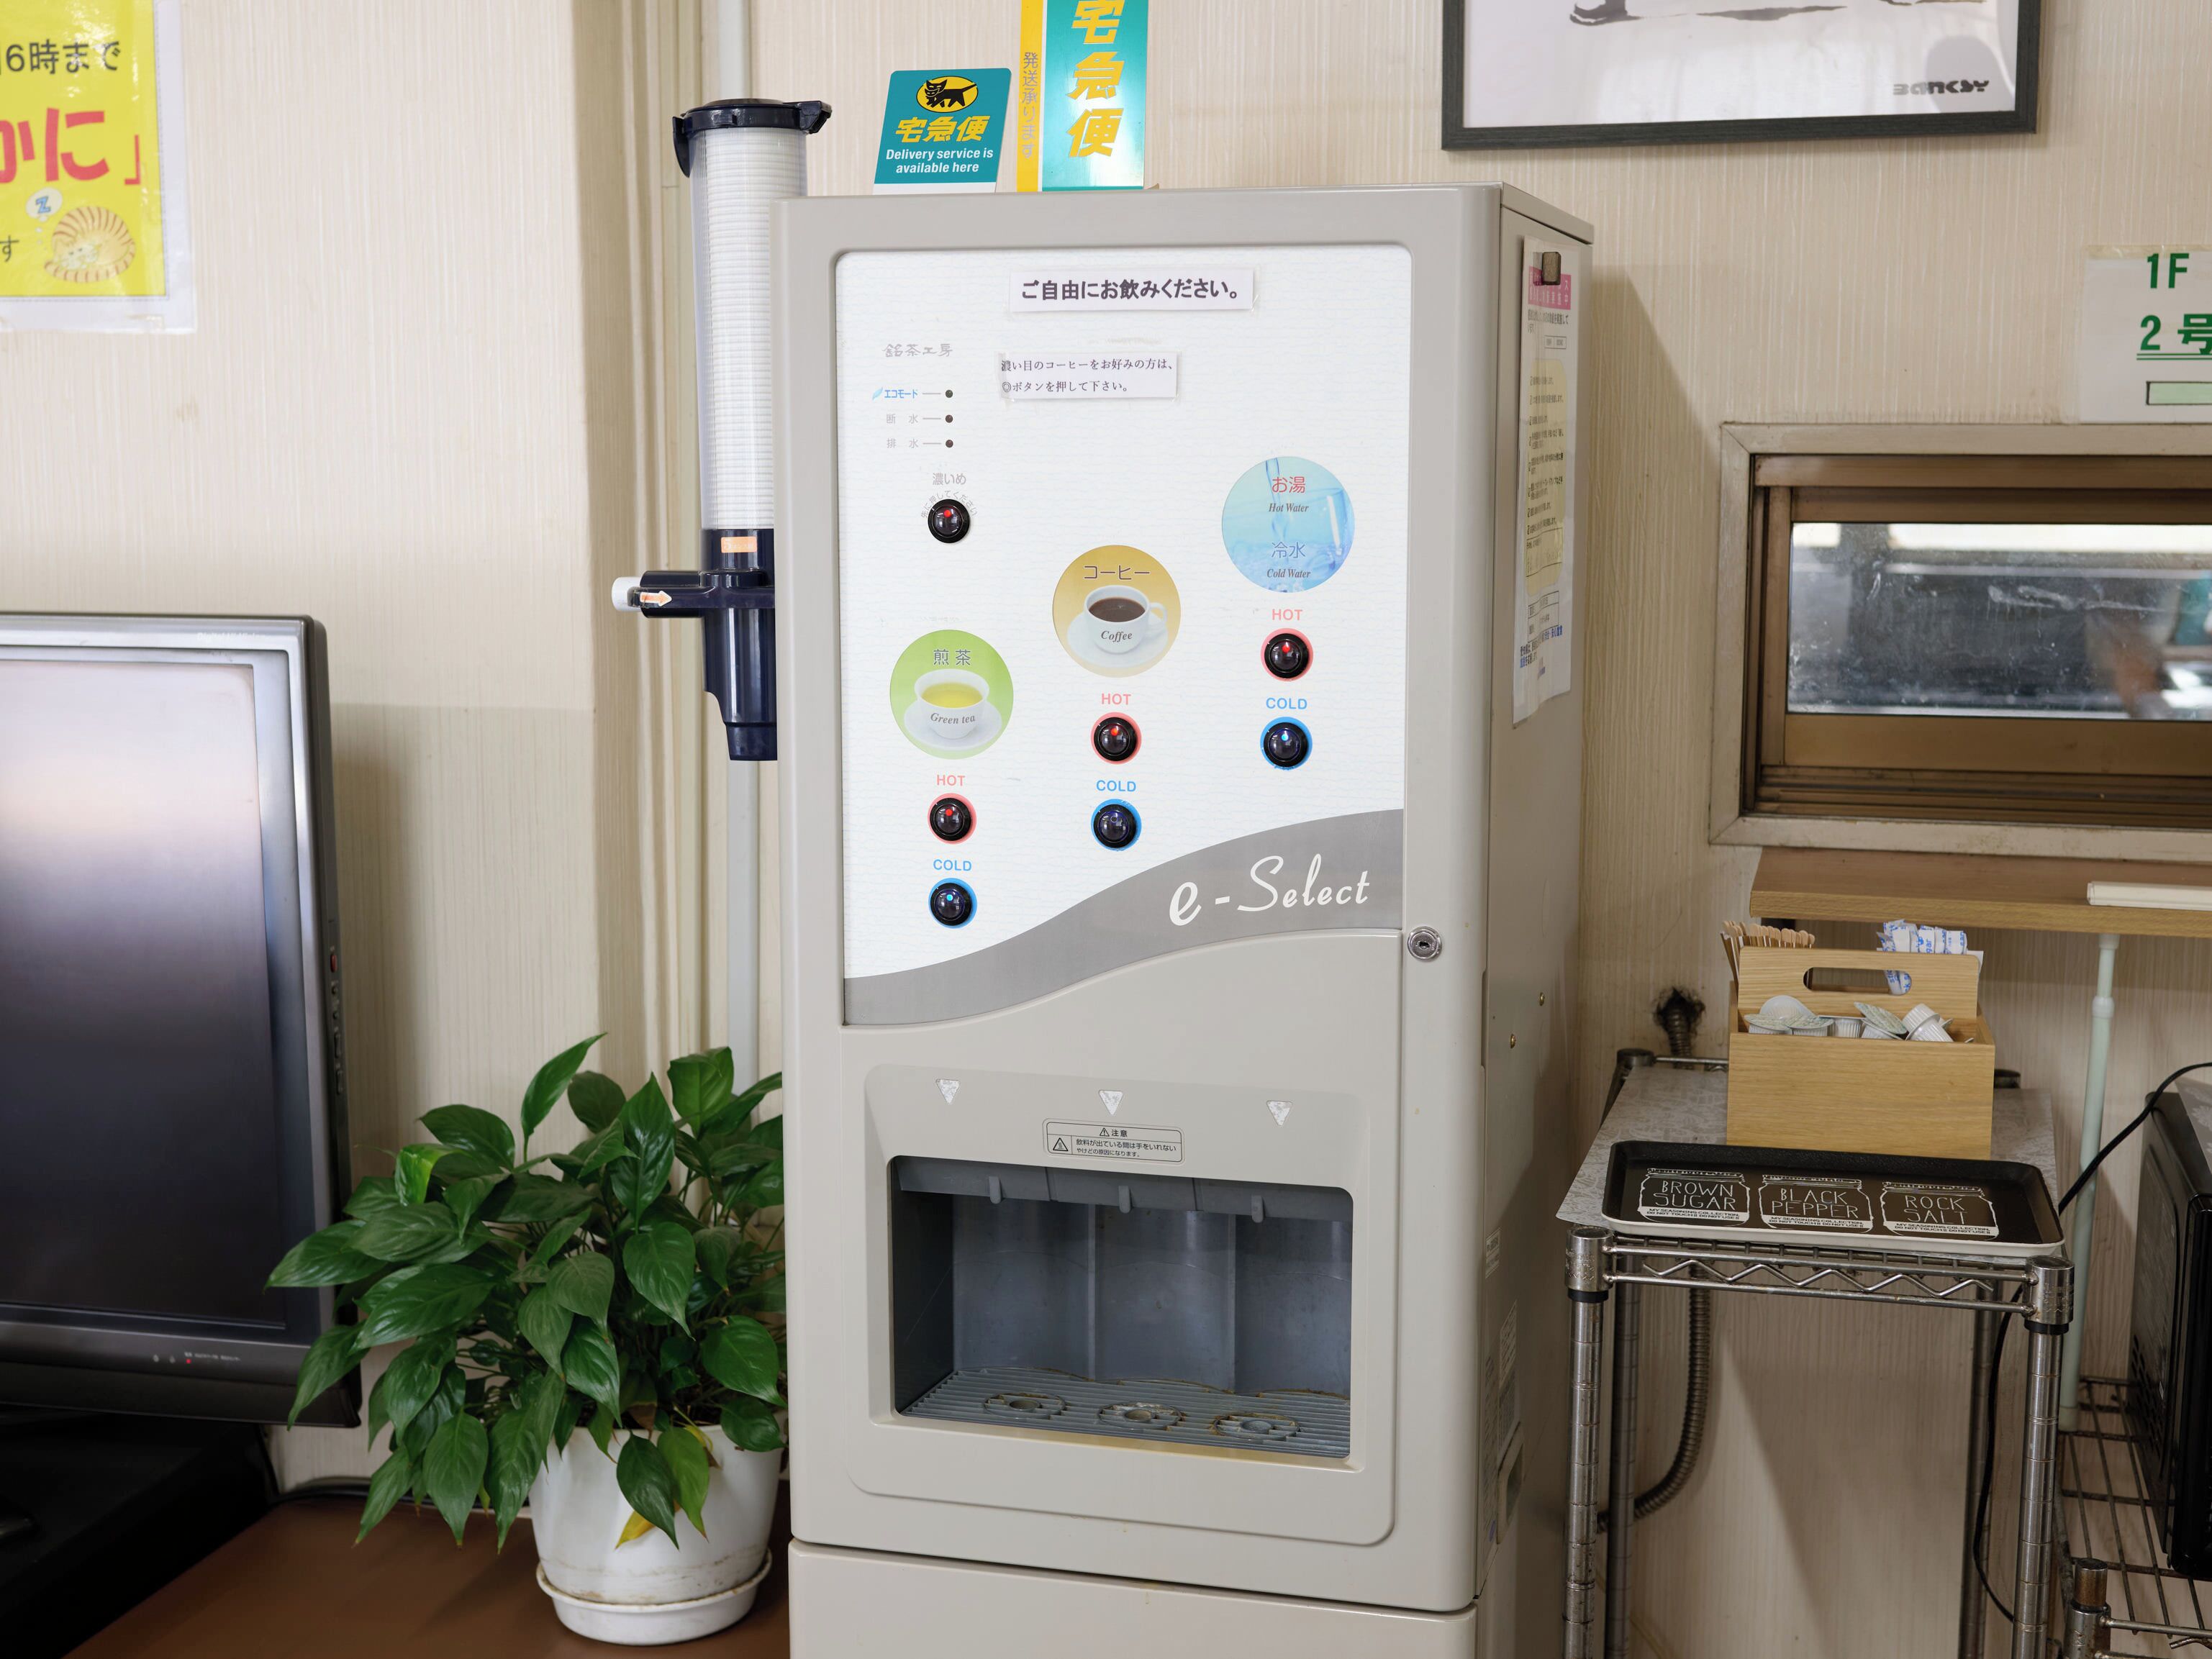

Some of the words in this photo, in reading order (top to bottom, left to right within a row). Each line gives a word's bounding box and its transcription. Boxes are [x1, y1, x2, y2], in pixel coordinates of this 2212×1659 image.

[0, 39, 121, 75] 6時まで
[1021, 52, 1038, 159] 発送承ります
[895, 115, 991, 142] 宅急便
[886, 149, 935, 161] Delivery
[937, 148, 981, 159] service
[983, 147, 994, 158] is
[896, 162, 950, 174] available
[952, 162, 979, 173] here
[2147, 253, 2190, 288] 1F
[1021, 278, 1238, 301] ご自由にお飲みください。
[1001, 358, 1174, 372] 濃い目のコーヒーをお好みの方は、
[884, 388, 918, 399] エコモード
[933, 472, 967, 486] 濃いめ
[1272, 476, 1306, 494] お湯
[1269, 502, 1284, 512] Hot
[1286, 502, 1309, 512] Water
[1271, 541, 1306, 559] 冷水
[1084, 565, 1151, 580] コーヒー
[1266, 568, 1285, 578] Cold
[1287, 568, 1311, 578] Water
[1272, 609, 1303, 621] HOT
[1100, 629, 1133, 642] Coffee
[933, 648, 971, 666] 煎茶
[1101, 693, 1132, 705] HOT
[1266, 697, 1307, 709] COLD
[930, 712, 959, 724] Green
[961, 714, 976, 724] tea
[936, 774, 966, 786] HOT
[1096, 780, 1136, 792] COLD
[933, 859, 972, 871] COLD
[1111, 1129, 1128, 1137] 注意
[1076, 1138, 1177, 1152] 飲料が出ている間は手をいれない
[1076, 1147, 1141, 1158] やけどの原因になります。
[1662, 1180, 1733, 1197] BROWN
[1653, 1193, 1736, 1211] SUGAR
[1780, 1188, 1848, 1205] BLACK
[1905, 1195, 1965, 1211] ROCK
[1772, 1201, 1859, 1219] PEPPER
[1904, 1209, 1967, 1225] SALT
